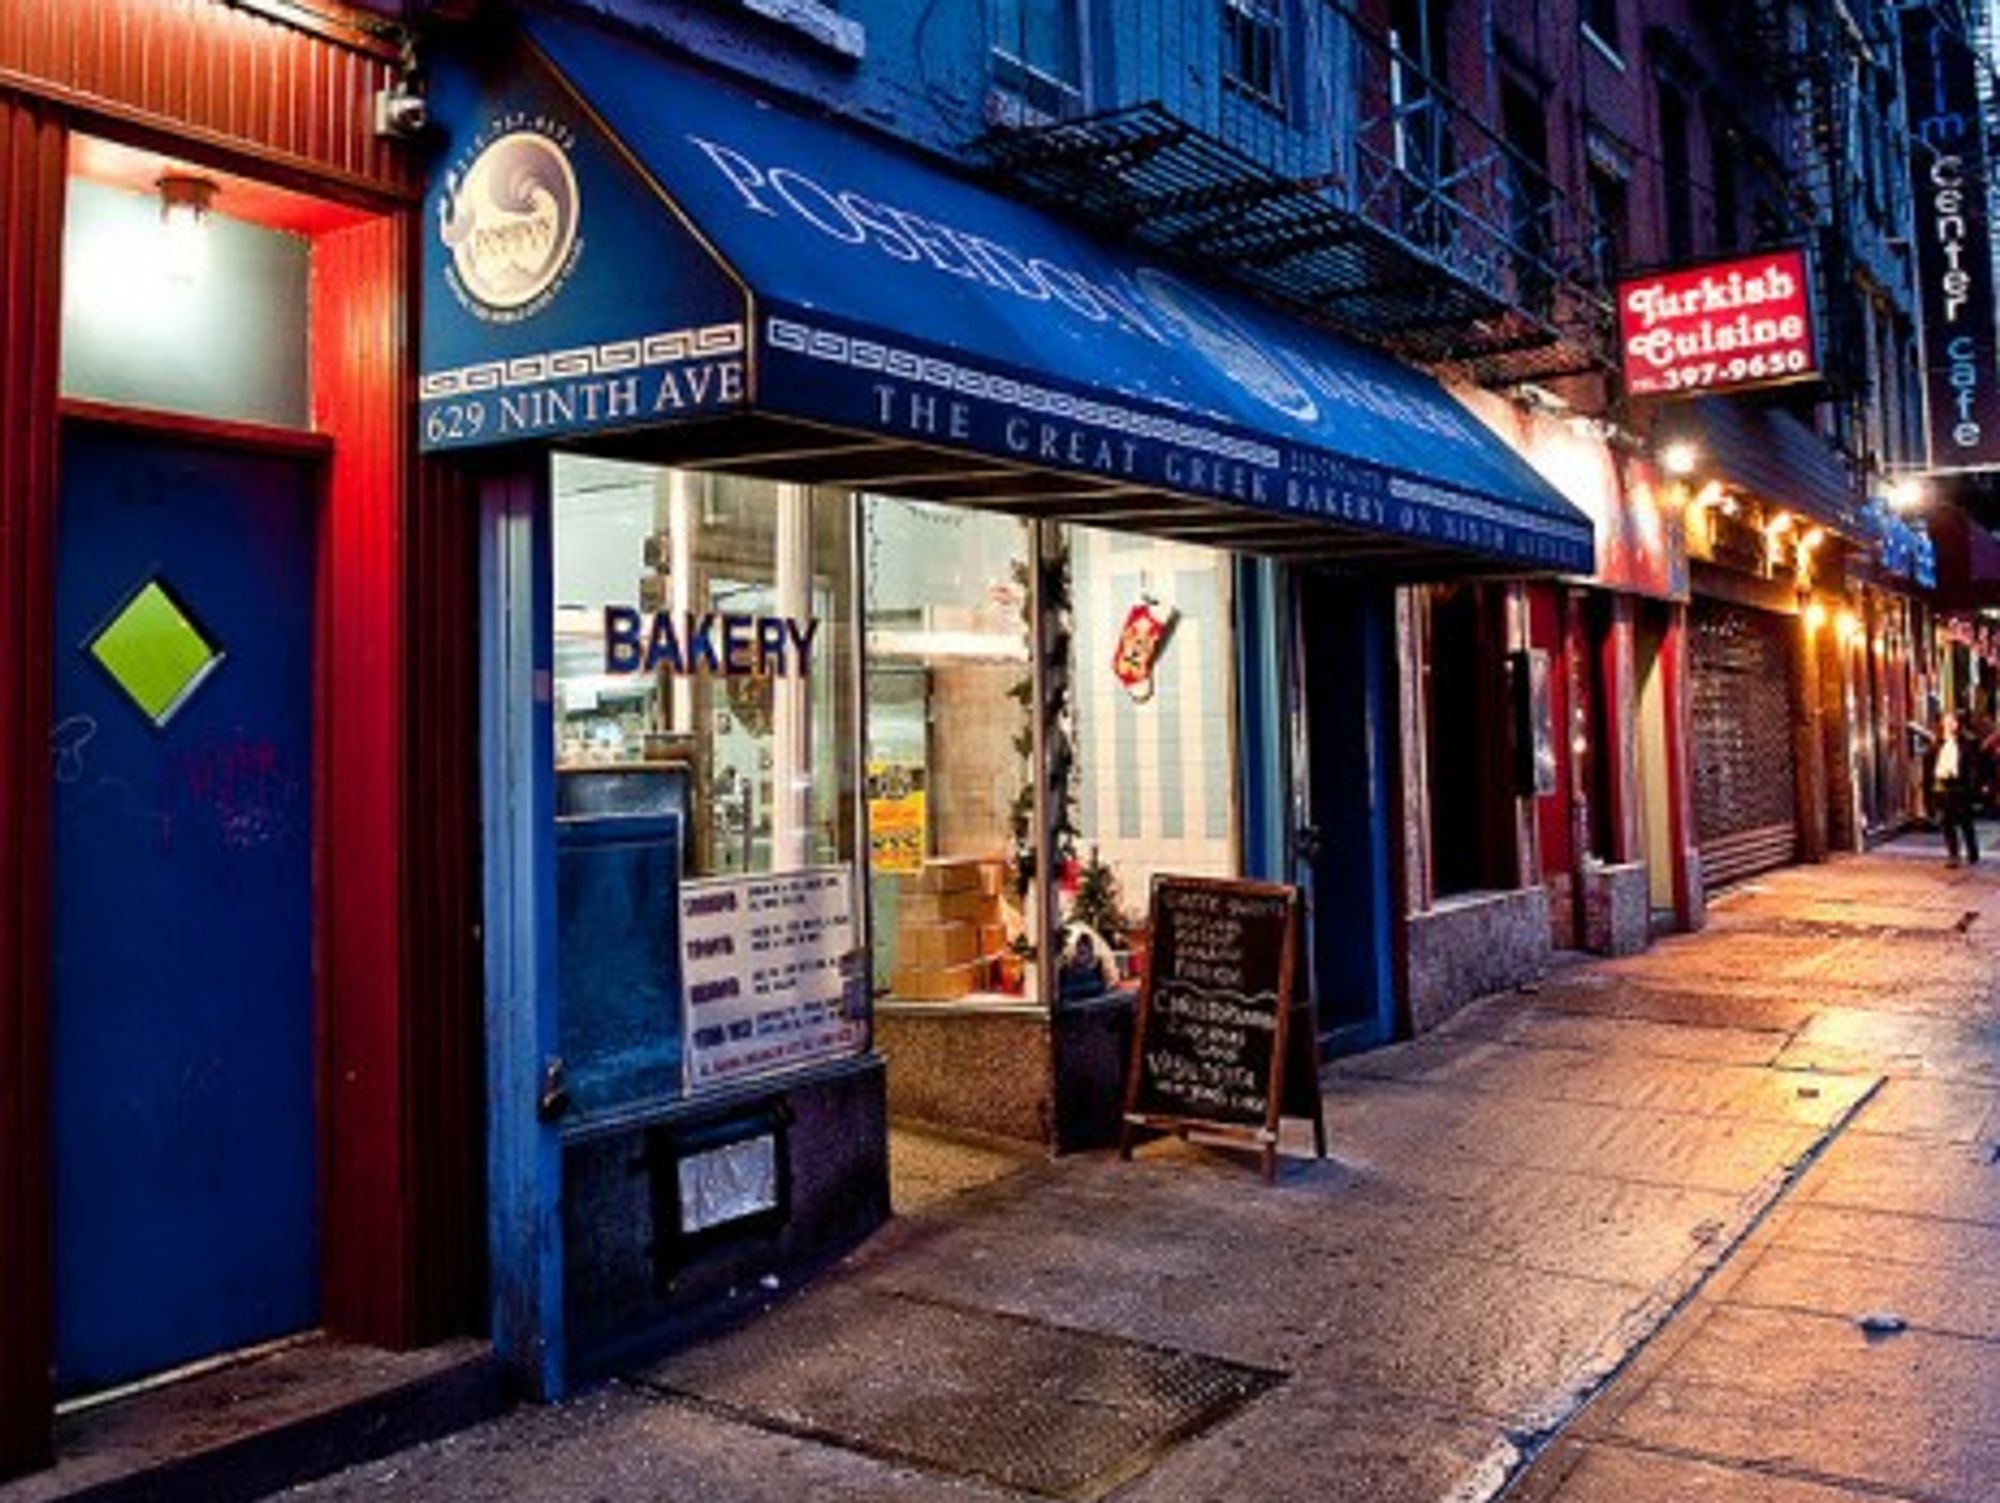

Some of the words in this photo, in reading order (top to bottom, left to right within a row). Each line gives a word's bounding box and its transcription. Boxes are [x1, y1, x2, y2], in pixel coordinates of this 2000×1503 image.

[1930, 154, 1970, 322] Center
[1628, 264, 1794, 327] Turkish
[1628, 314, 1803, 367] Cuisine
[1663, 350, 1806, 390] 397-9650
[427, 402, 485, 441] 629
[500, 376, 641, 432] NINTH
[653, 362, 744, 411] AVE
[873, 384, 969, 438] THE
[1006, 416, 1137, 472] GREAT
[1165, 452, 1267, 502] GREEK
[1287, 479, 1384, 523] BAKERY
[1400, 506, 1431, 533] ON
[605, 605, 820, 678] BAKERY
